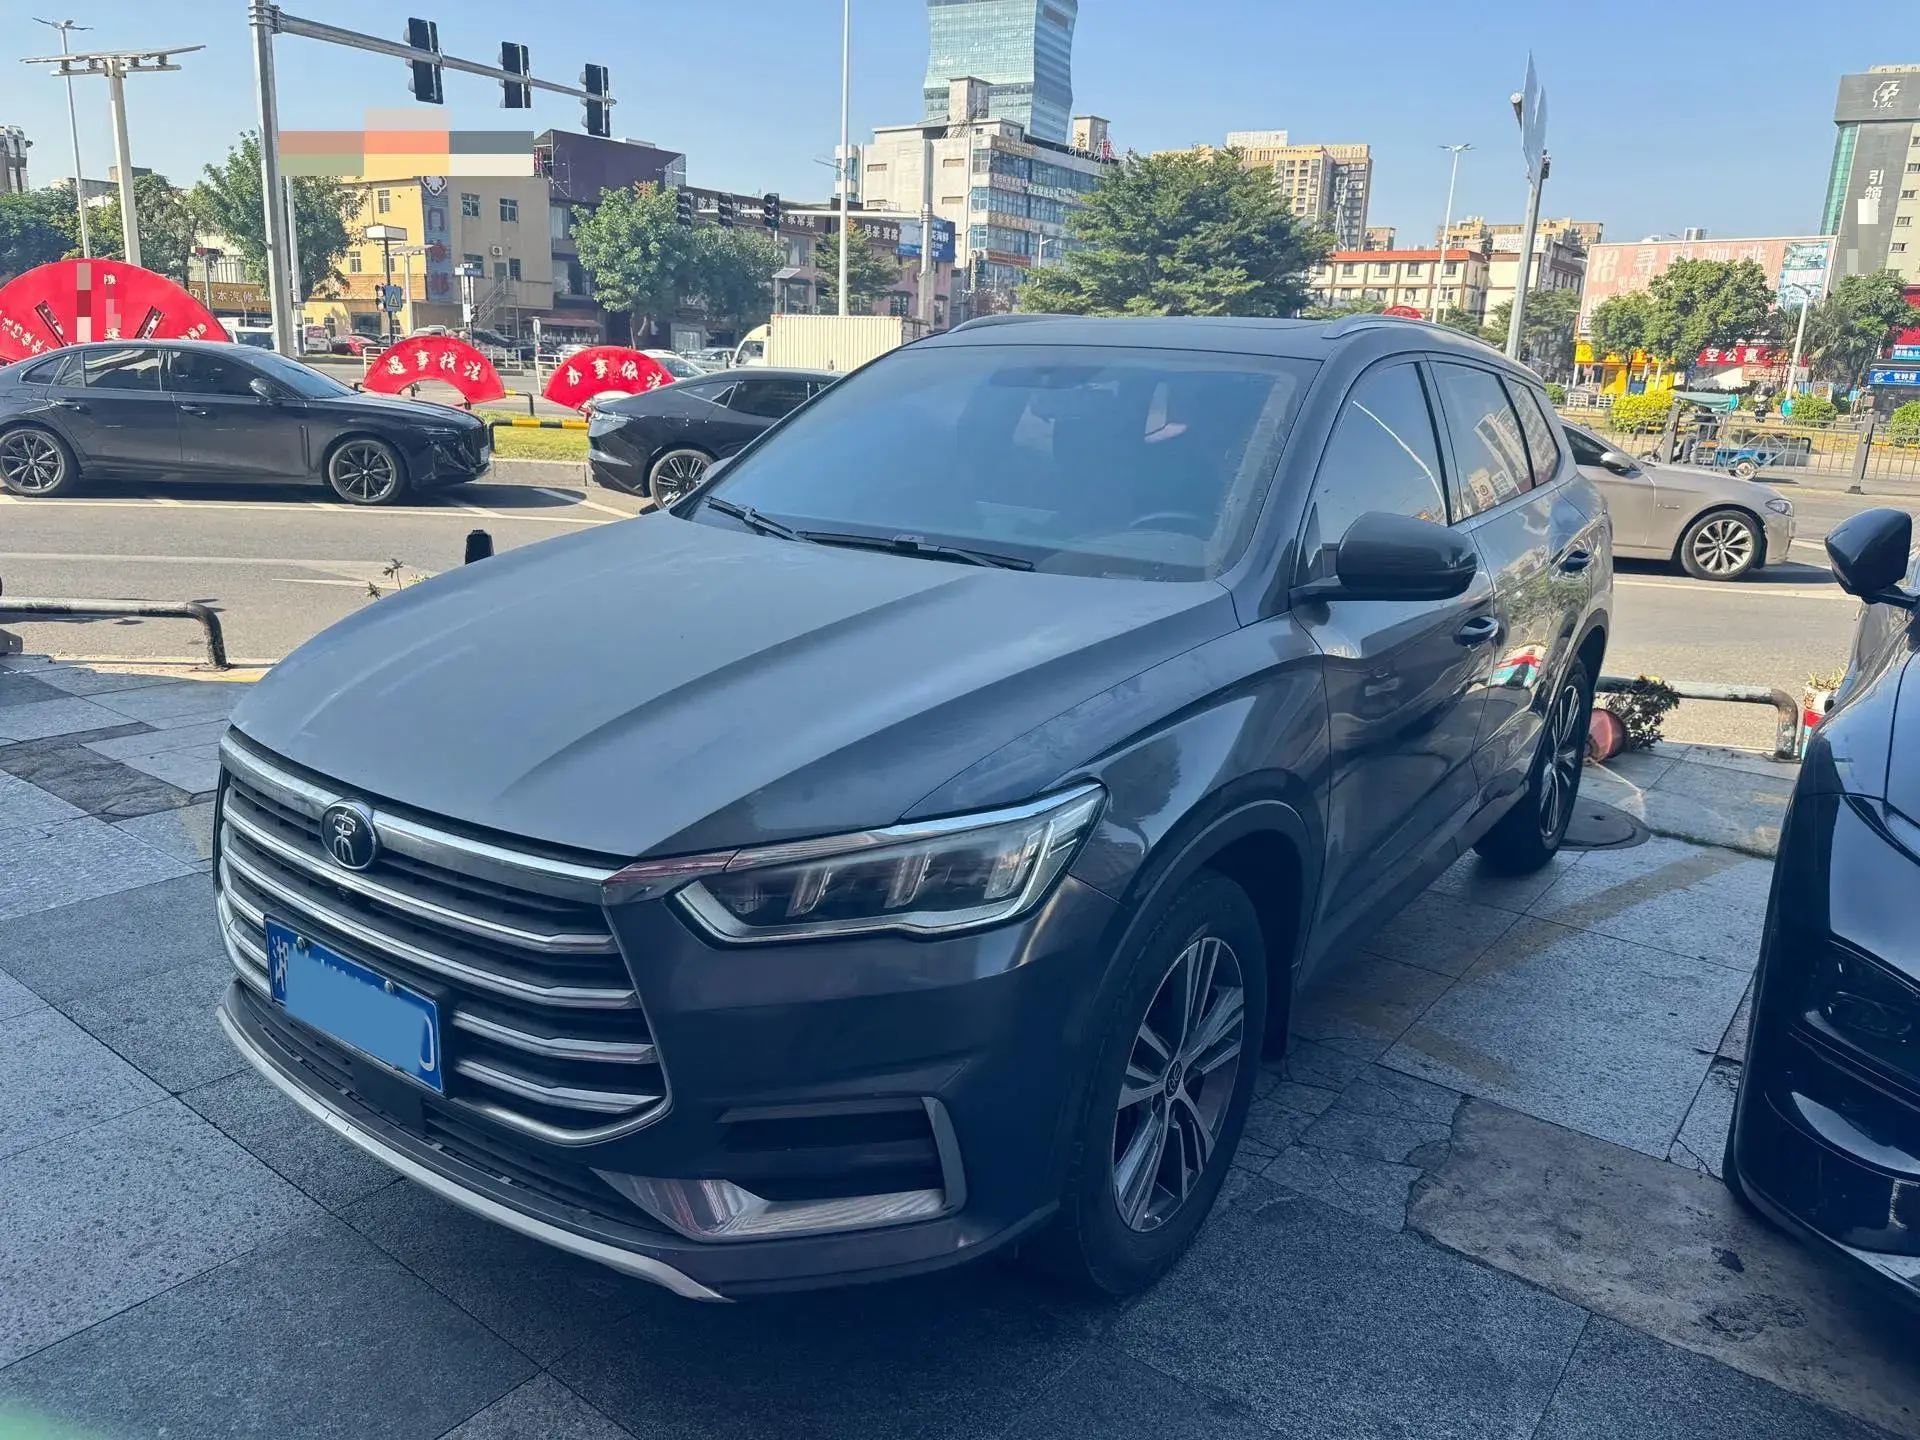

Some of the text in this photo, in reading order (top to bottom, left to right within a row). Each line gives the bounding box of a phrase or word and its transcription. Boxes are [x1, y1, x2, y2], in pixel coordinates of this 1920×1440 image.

[387, 349, 483, 379] 遇事找法
[566, 358, 663, 388] 办事依法
